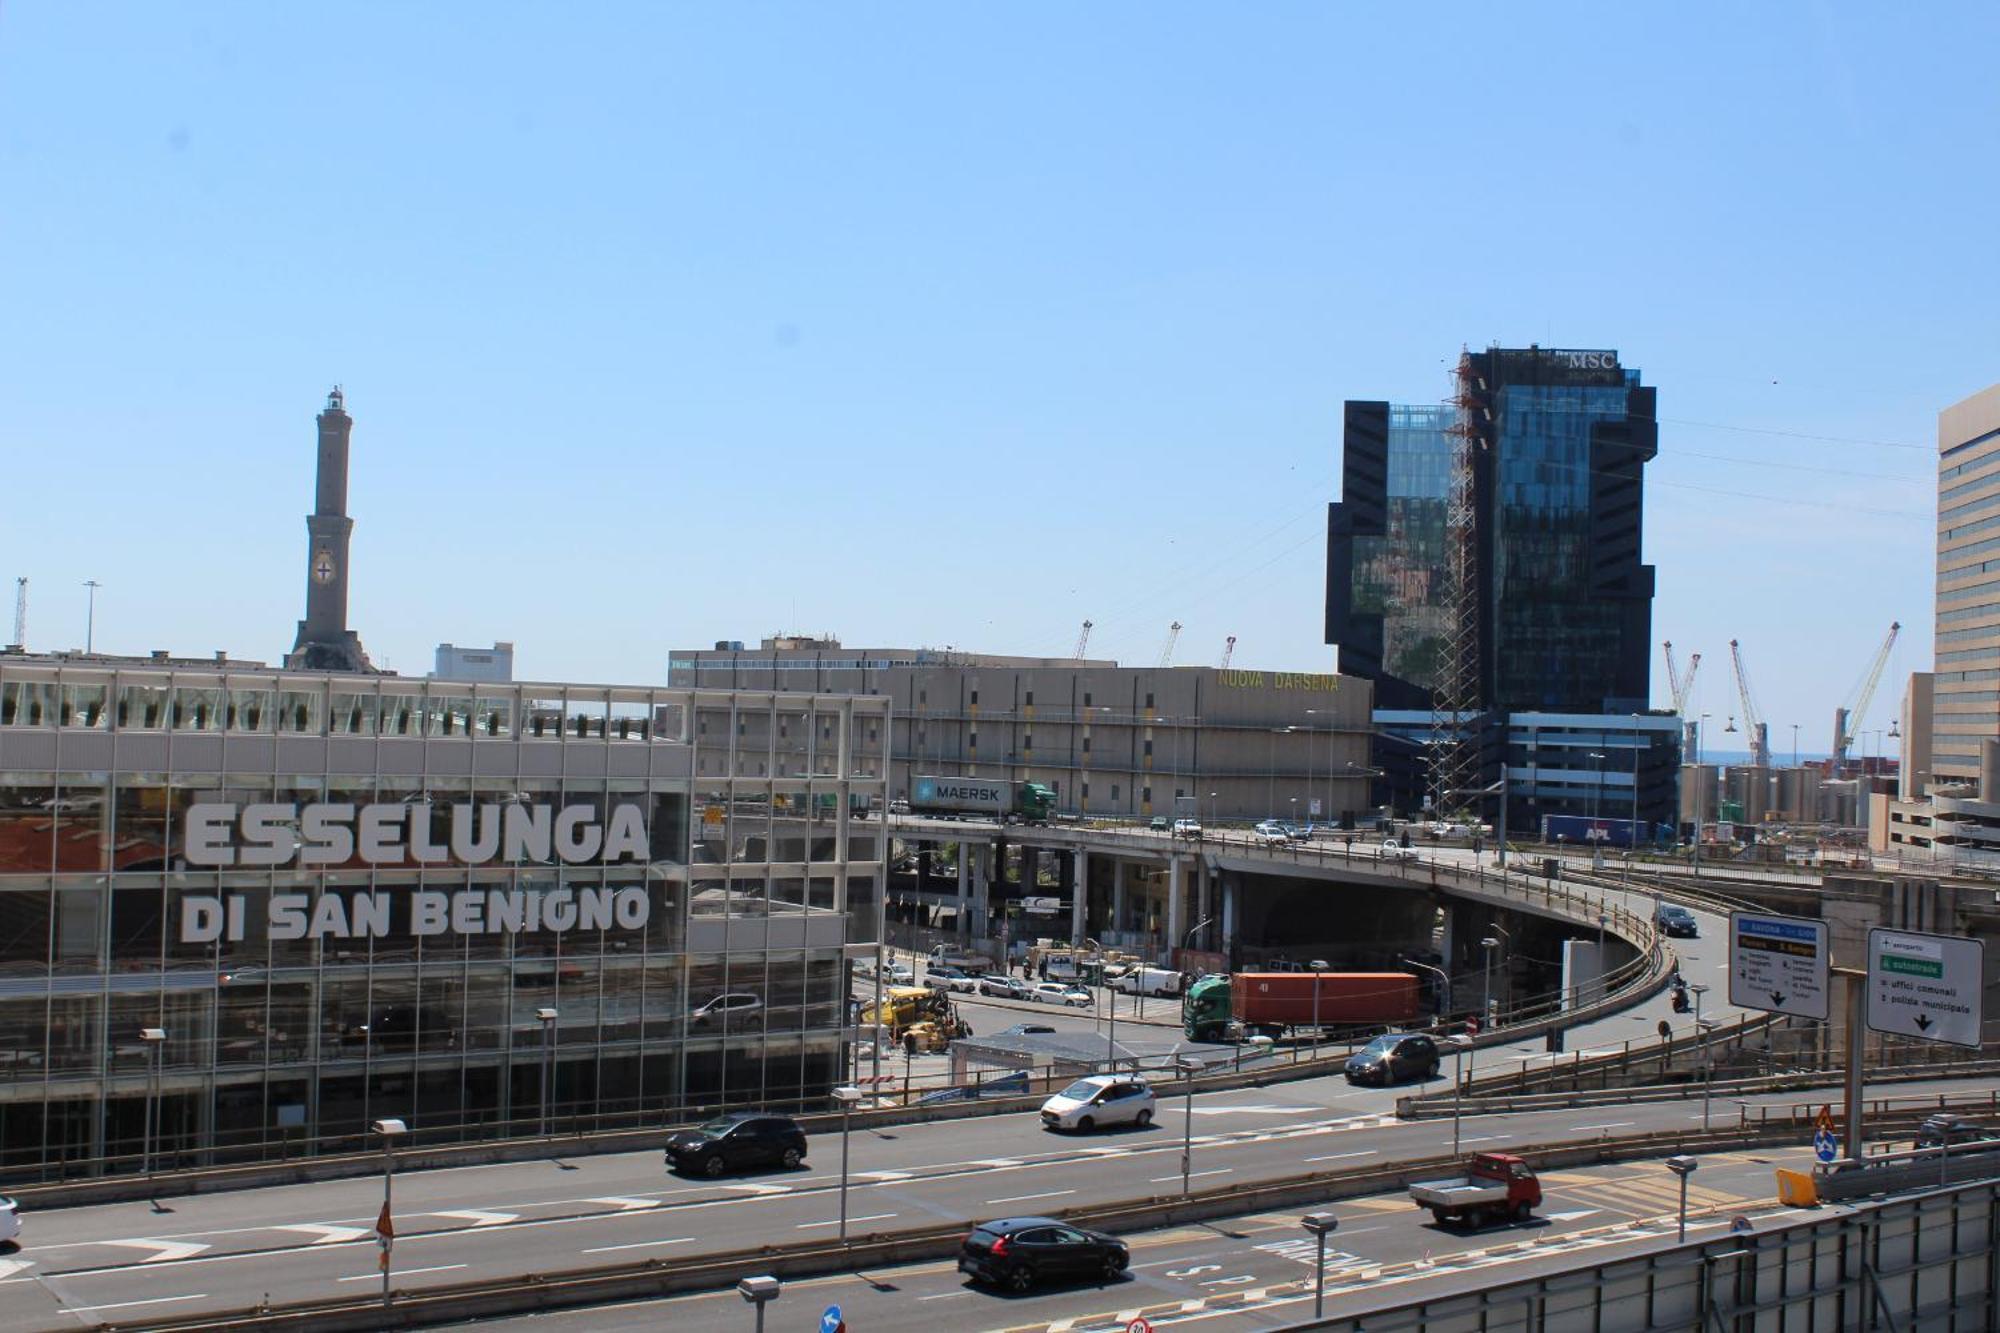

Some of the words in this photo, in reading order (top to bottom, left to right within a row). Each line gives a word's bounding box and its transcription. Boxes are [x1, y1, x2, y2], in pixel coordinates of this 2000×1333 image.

[1568, 351, 1616, 369] MSC
[1218, 670, 1264, 688] NUOVA
[1274, 673, 1339, 692] DARSENA
[936, 785, 1000, 801] MAERSK
[184, 802, 652, 865] ESSELUNGA
[1585, 828, 1611, 841] APL
[181, 895, 245, 944] DI
[267, 893, 391, 940] SAN
[410, 886, 652, 937] BENIGNO
[1891, 980, 1914, 991] uffici
[1917, 985, 1957, 997] comunali
[1891, 995, 1918, 1007] polizia
[1921, 1000, 1970, 1014] municipale
